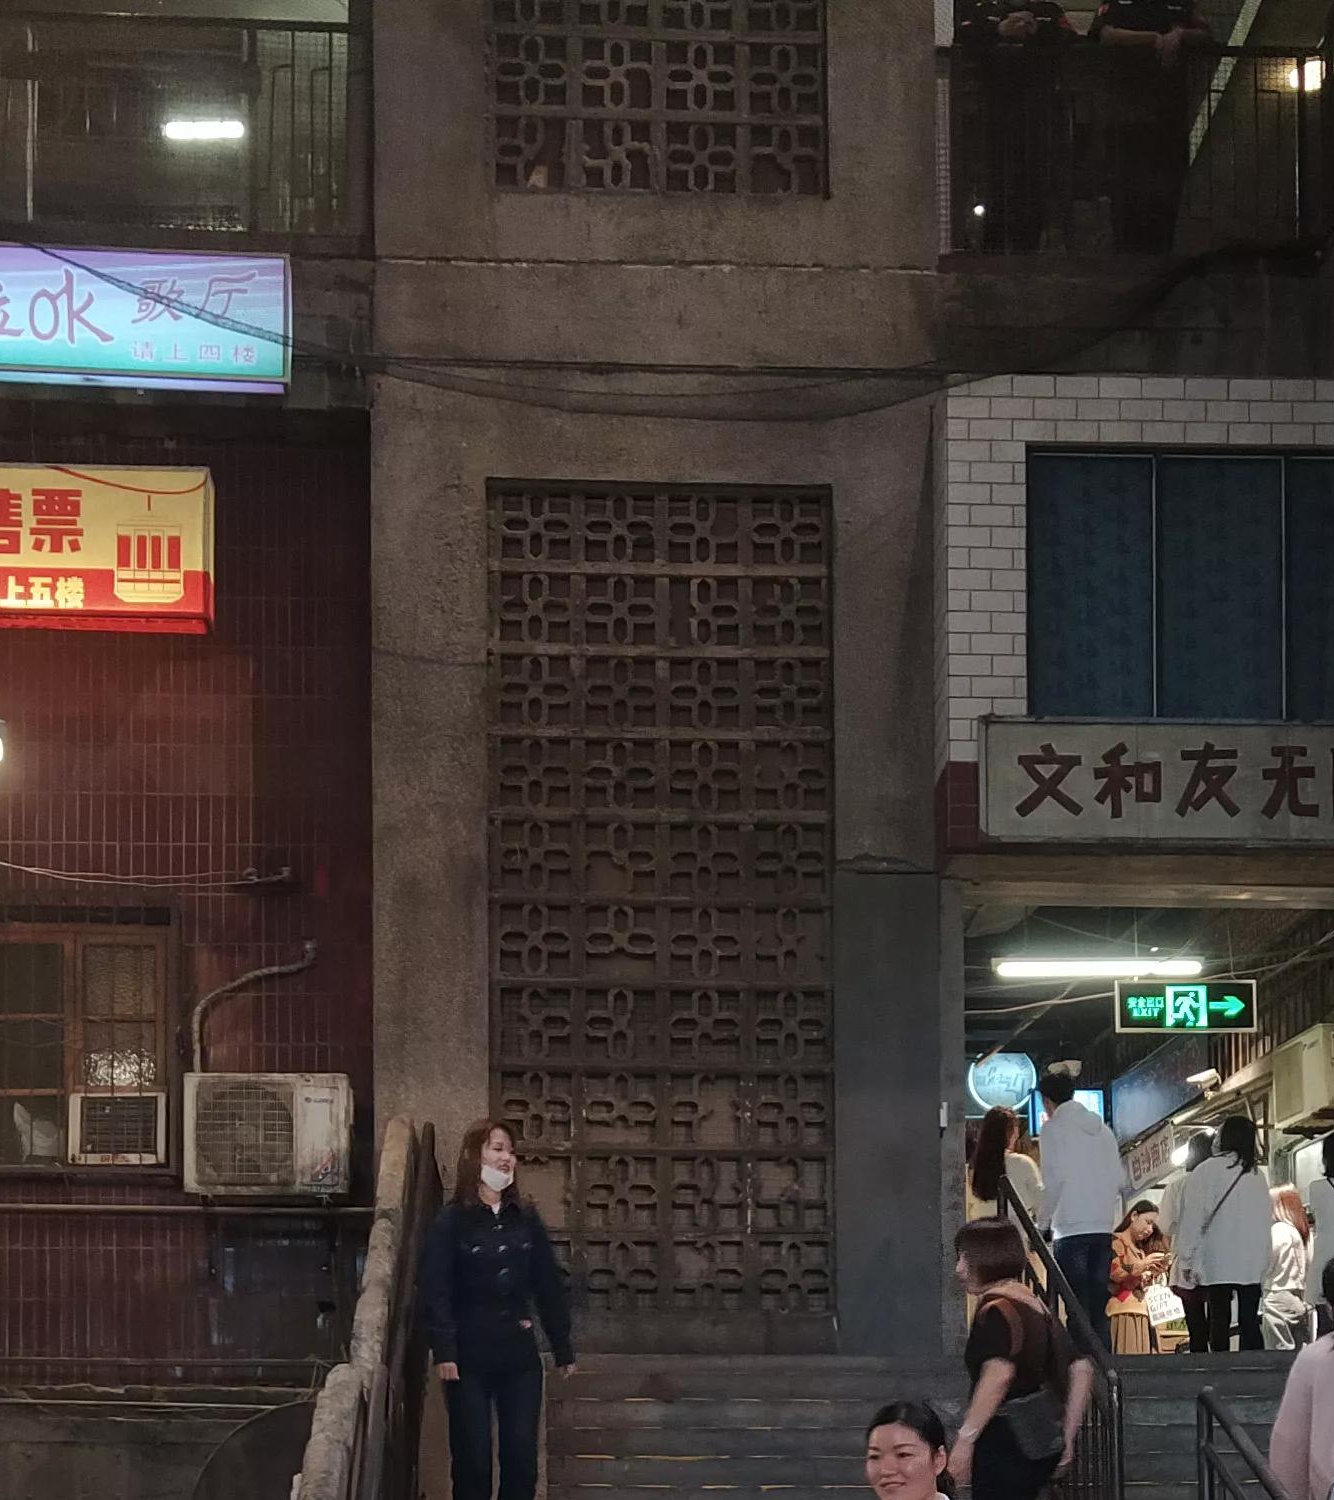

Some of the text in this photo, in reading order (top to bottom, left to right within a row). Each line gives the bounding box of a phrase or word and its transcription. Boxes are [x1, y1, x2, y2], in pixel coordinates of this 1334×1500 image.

[130, 270, 261, 325] 歌厅
[131, 341, 258, 365] 请上四楼
[1131, 1007, 1161, 1018] EXIT
